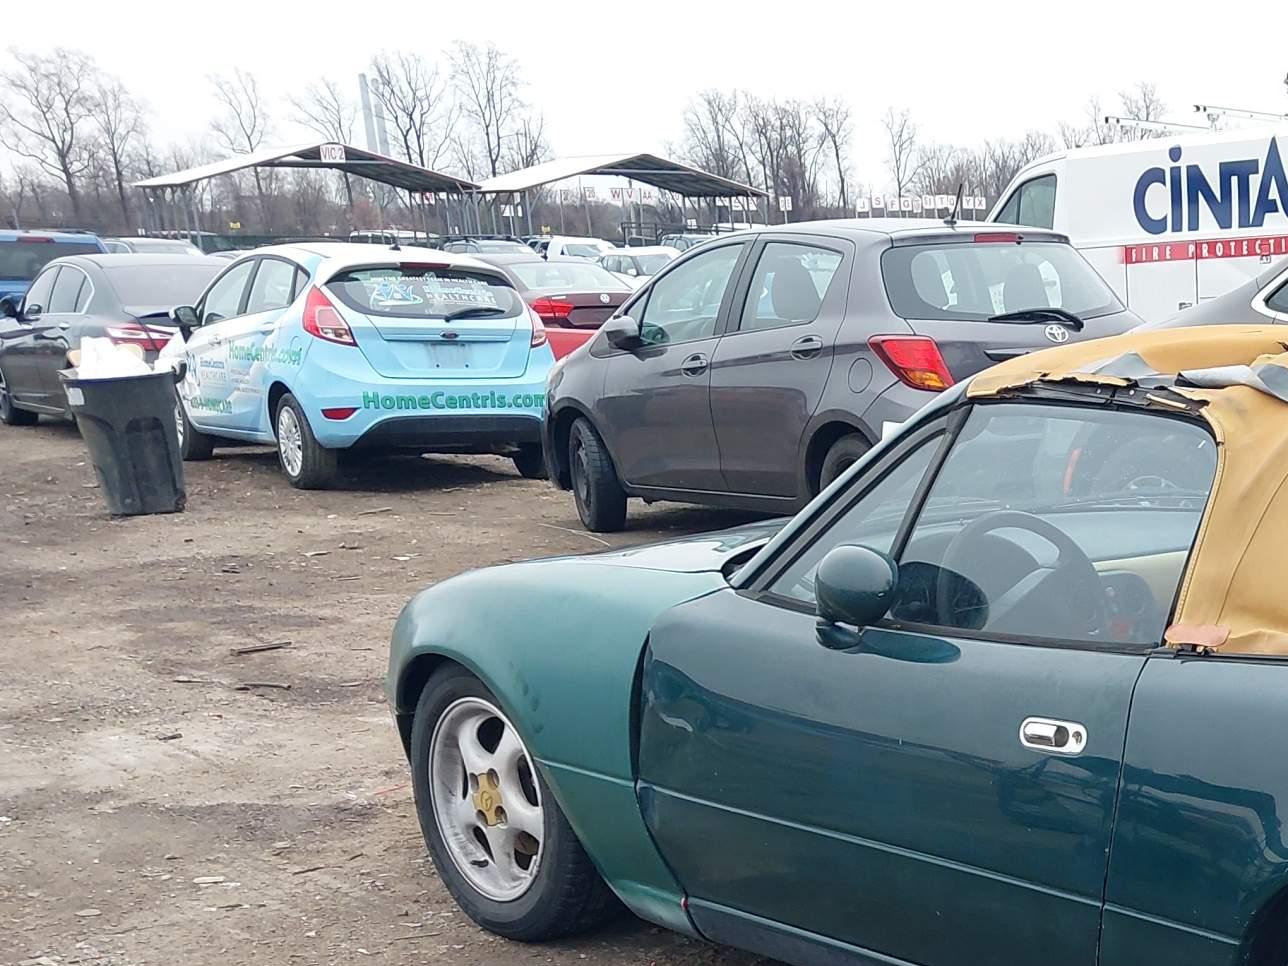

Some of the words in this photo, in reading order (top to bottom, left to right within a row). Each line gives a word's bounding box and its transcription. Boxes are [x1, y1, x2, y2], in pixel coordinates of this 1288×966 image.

[321, 146, 336, 160] VIC
[338, 147, 345, 160] 2
[610, 189, 621, 199] W
[626, 190, 633, 199] V
[1131, 246, 1171, 262] FIRE
